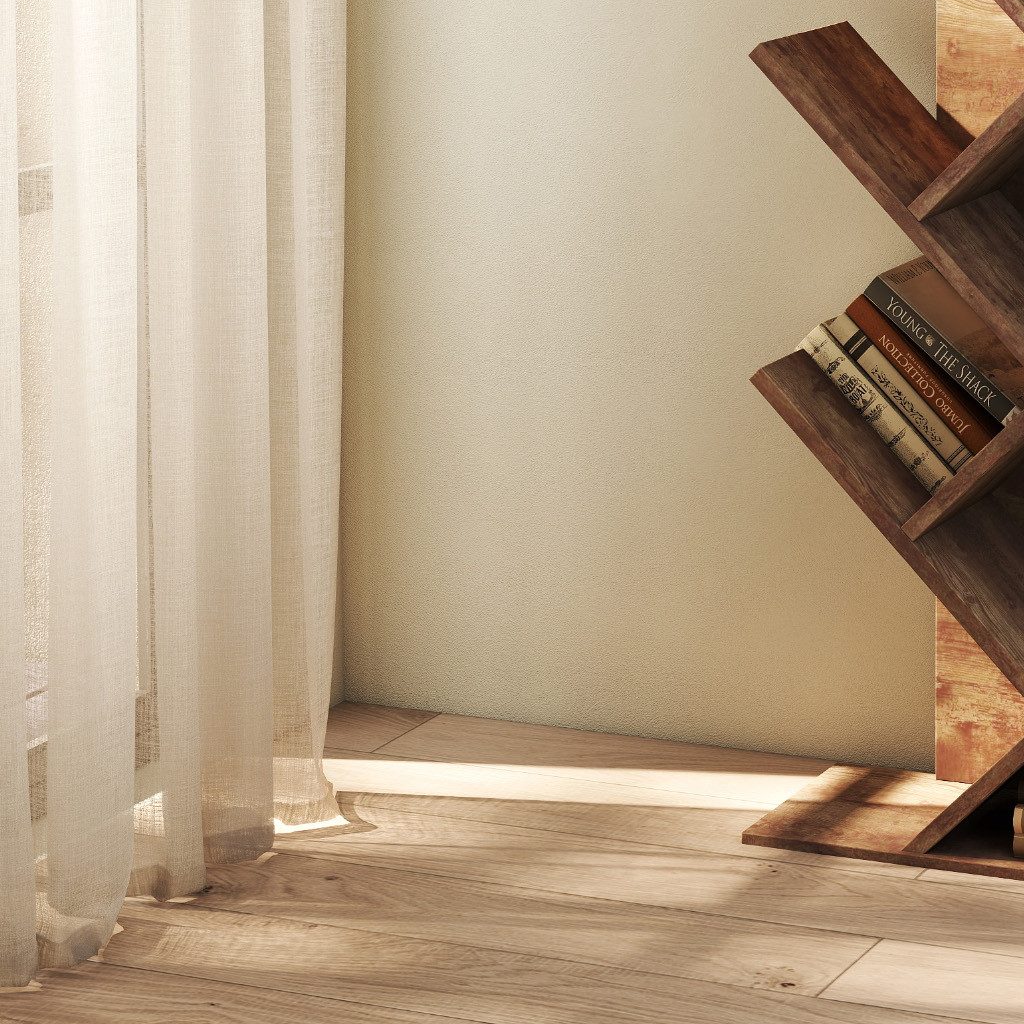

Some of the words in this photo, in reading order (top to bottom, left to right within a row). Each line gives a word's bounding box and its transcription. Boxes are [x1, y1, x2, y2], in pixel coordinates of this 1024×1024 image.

[878, 335, 935, 398] COLLECTION
[886, 297, 928, 340] YOUNG
[933, 342, 958, 373] THE
[956, 365, 997, 407] SHACK
[936, 398, 971, 434] JUMBO
